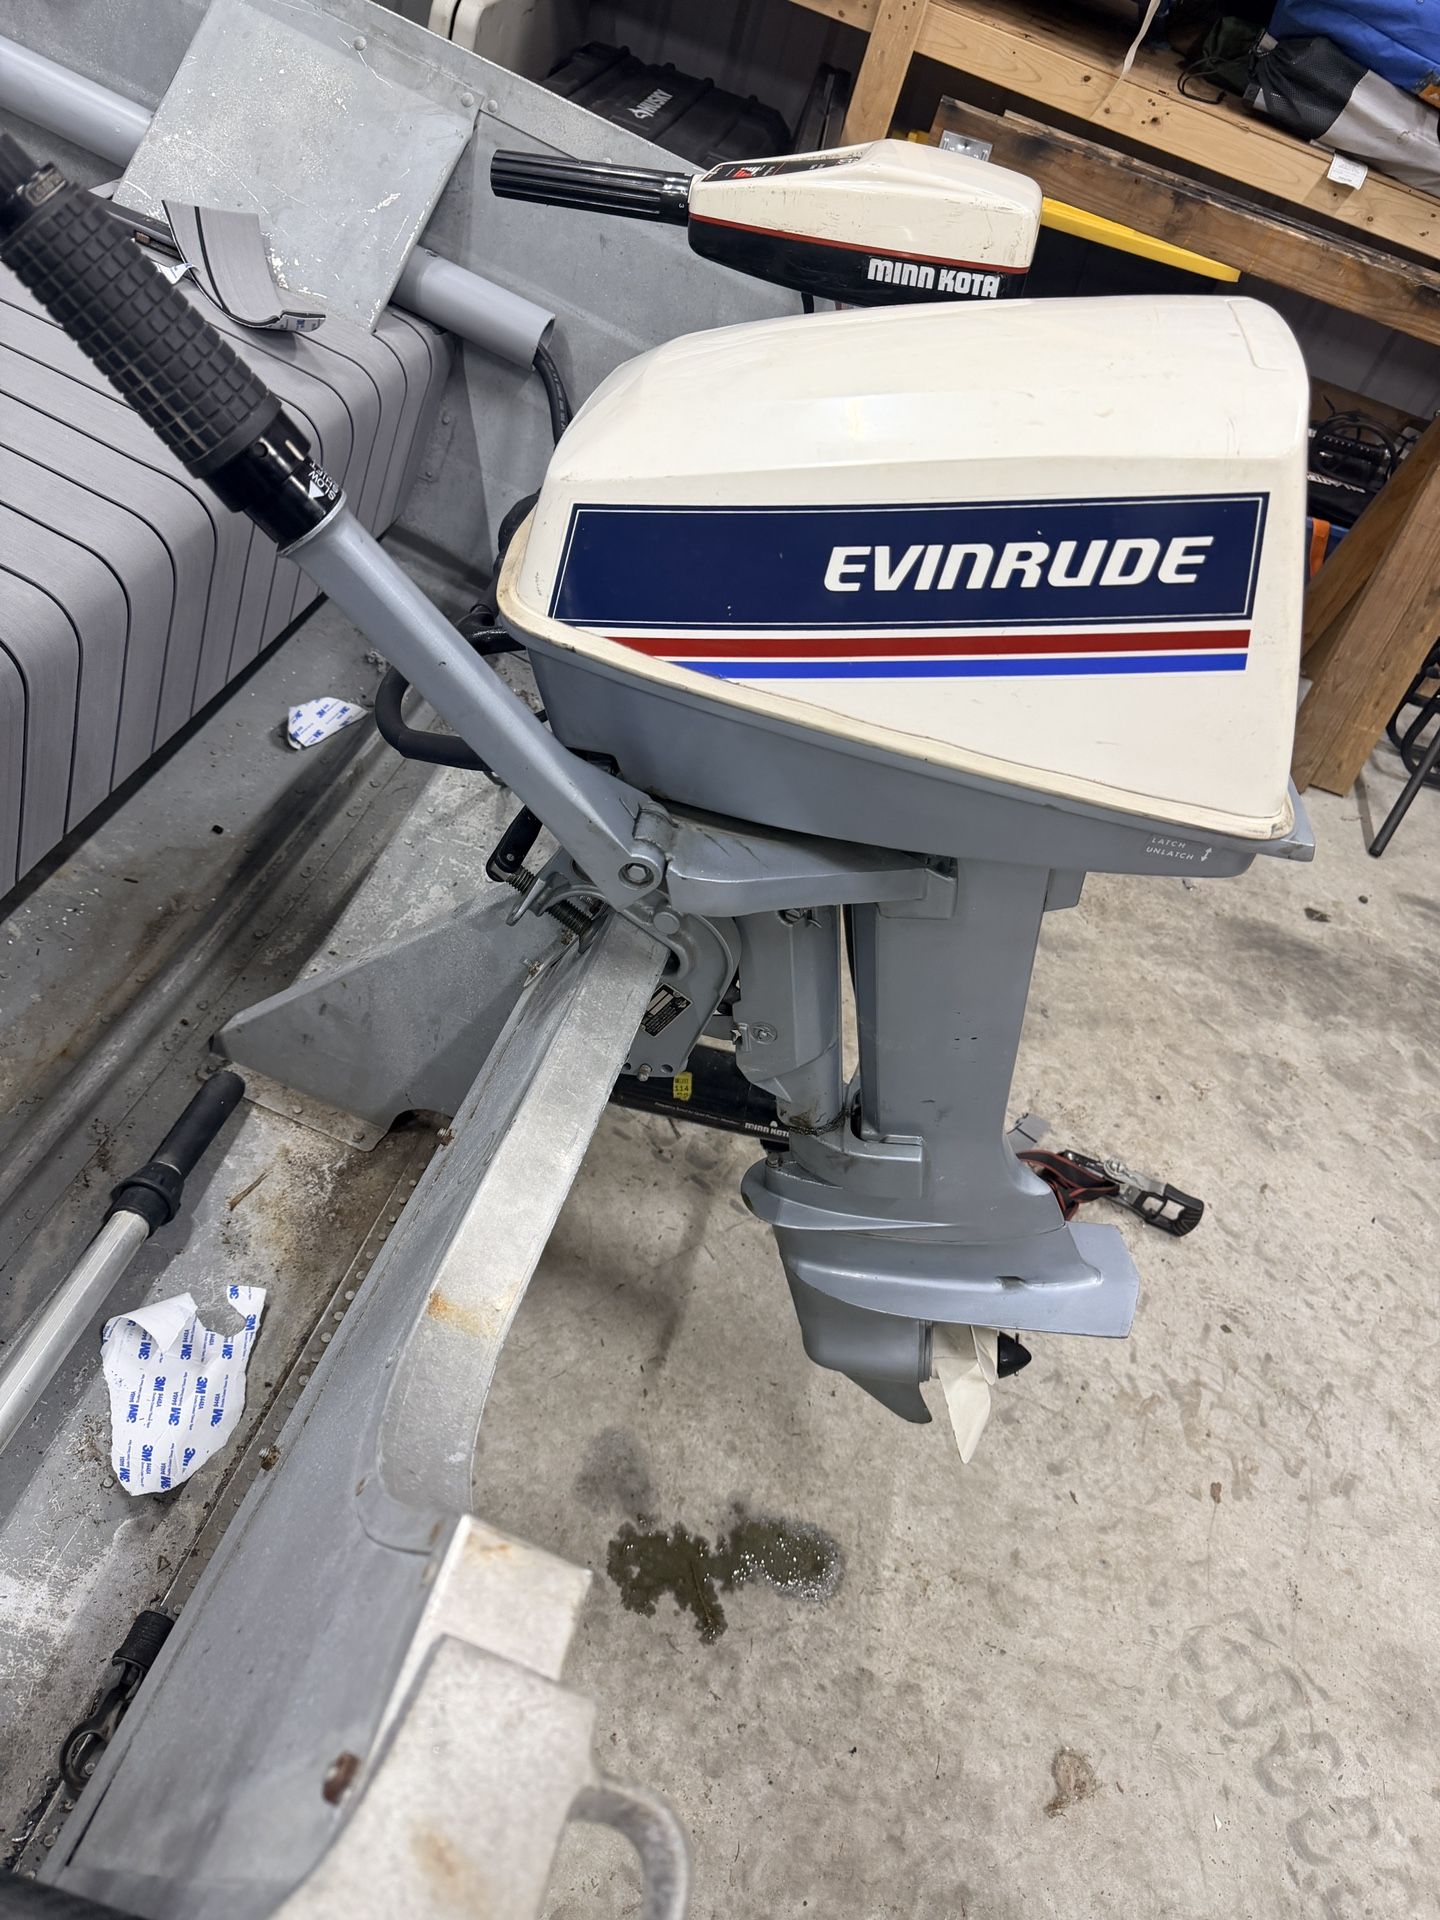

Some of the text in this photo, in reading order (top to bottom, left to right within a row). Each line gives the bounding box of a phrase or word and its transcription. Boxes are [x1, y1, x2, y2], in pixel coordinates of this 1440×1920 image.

[635, 88, 673, 114] HUSKY
[867, 258, 1001, 299] MINN KOTA
[308, 470, 337, 500] SLOW
[823, 536, 1214, 592] EVINRUDE
[1151, 838, 1186, 848] LATCH
[1146, 846, 1194, 860] UNLATCH
[744, 1122, 770, 1134] MINN
[138, 1342, 152, 1360] 3M
[180, 1344, 192, 1360] 3M
[222, 1344, 234, 1360] 3M
[154, 1376, 166, 1392] 3M
[196, 1376, 208, 1394] 3M
[128, 1404, 139, 1423] 3M
[168, 1407, 182, 1426] 3M
[210, 1408, 224, 1427] 3M
[141, 1444, 154, 1462] 3M
[120, 1468, 130, 1482] 3M
